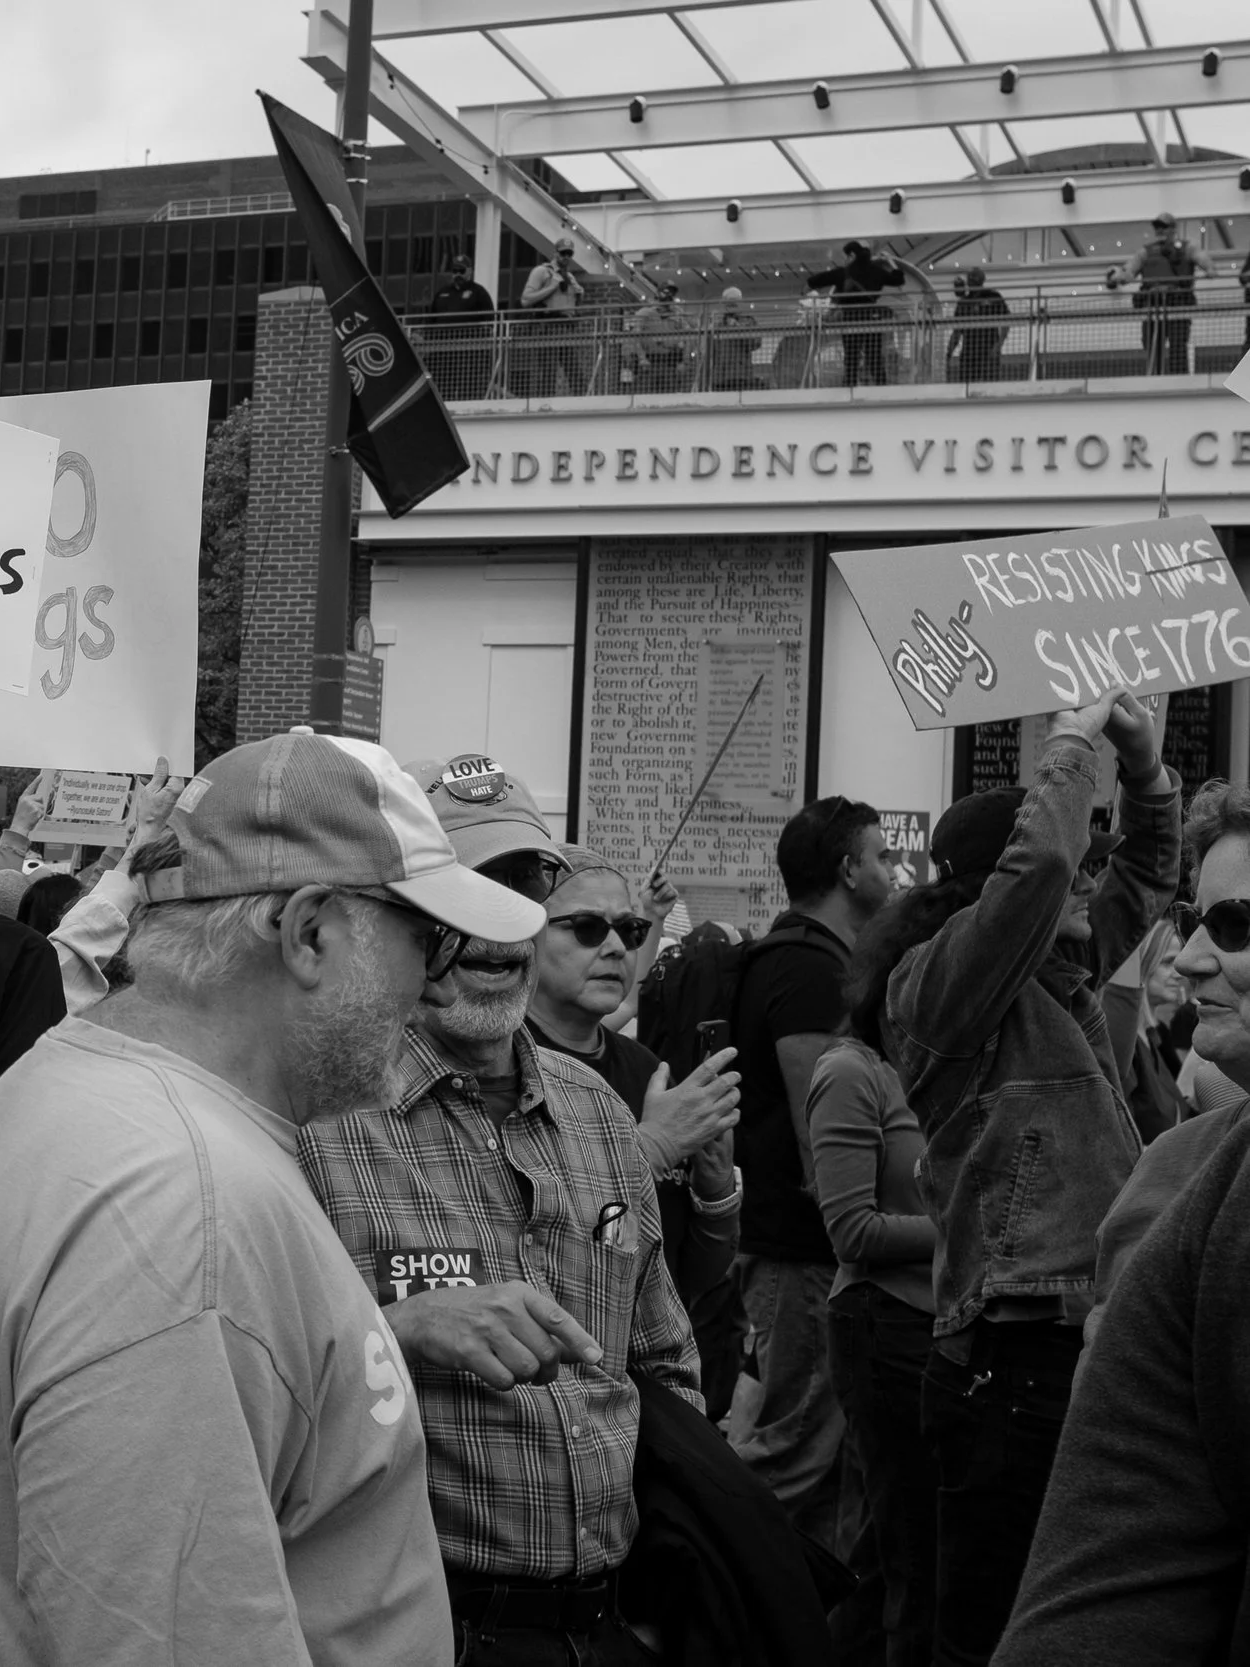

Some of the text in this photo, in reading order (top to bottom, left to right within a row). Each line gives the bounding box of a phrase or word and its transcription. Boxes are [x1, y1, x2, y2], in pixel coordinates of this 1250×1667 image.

[450, 440, 874, 485] NDEPENDENCE
[902, 434, 1153, 474] VISITOR
[962, 539, 1228, 615] RESISTING KINGS
[596, 588, 641, 600] among
[647, 585, 681, 597] these
[686, 588, 706, 597] are
[596, 598, 618, 610] and
[624, 598, 645, 610] the
[650, 598, 696, 610] Pursuit
[702, 598, 715, 610] of
[597, 612, 628, 624] That
[640, 613, 653, 624] to
[662, 614, 704, 624] secure
[709, 611, 745, 624] these
[595, 624, 802, 637] Governments are instituted
[594, 640, 639, 652] among
[645, 637, 676, 650] Men,
[594, 651, 639, 662] Powers
[642, 650, 673, 662] from
[678, 650, 699, 662] the
[1035, 608, 1250, 705] SINCE 1776
[593, 664, 663, 678] Governed,
[671, 664, 697, 676] that
[593, 677, 627, 689] Form
[631, 676, 647, 688] of
[592, 689, 663, 702] destructive
[669, 690, 684, 701] of
[592, 704, 612, 715] the
[617, 703, 652, 718] Right
[658, 703, 672, 715] of
[675, 704, 697, 715] the
[591, 718, 605, 728] or
[612, 718, 625, 728] to
[632, 716, 678, 728] abolish
[682, 716, 696, 730] it,
[590, 732, 617, 741] new
[590, 742, 685, 754] Foundation on
[974, 746, 1000, 760] and
[450, 758, 495, 778] LOVE
[589, 755, 613, 767] and
[622, 757, 693, 771] organizing
[973, 761, 1007, 774] such
[457, 774, 498, 789] TRUMPS
[588, 769, 683, 782] such Form, as
[470, 785, 492, 796] HATE
[588, 784, 620, 793] seem
[627, 784, 659, 794] most
[587, 795, 626, 810] Safety
[635, 796, 658, 808] and
[595, 807, 634, 820] When
[638, 809, 650, 820] in
[654, 808, 675, 821] the
[730, 812, 744, 823] of
[910, 814, 918, 830] A
[587, 820, 634, 835] Events,
[643, 824, 651, 834] it
[587, 835, 606, 845] for
[611, 838, 636, 846] one
[694, 838, 706, 849] to
[713, 836, 766, 851] dissolve
[708, 850, 749, 864] which
[698, 864, 727, 876] with
[390, 1254, 470, 1277] SHOW
